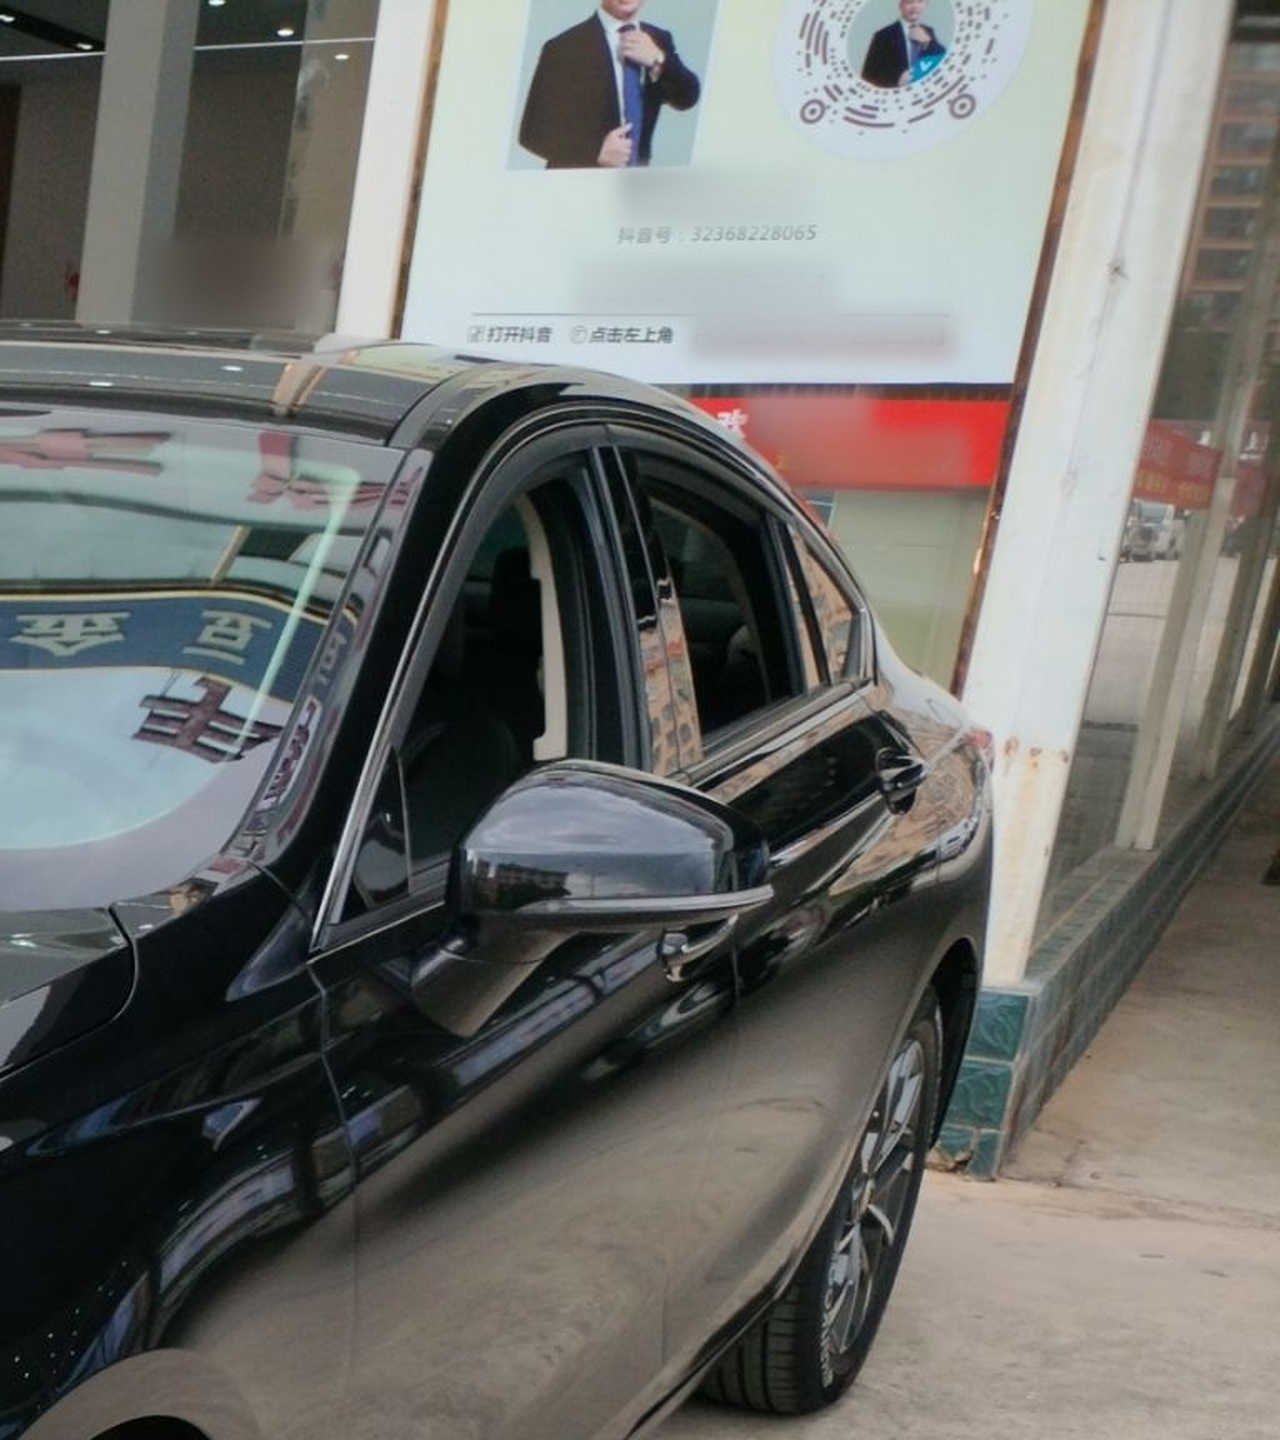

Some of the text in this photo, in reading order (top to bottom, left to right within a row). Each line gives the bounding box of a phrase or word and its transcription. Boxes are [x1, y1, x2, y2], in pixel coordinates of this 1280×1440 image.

[487, 326, 553, 343] 打开抖音
[590, 326, 674, 343] 点击左上角
